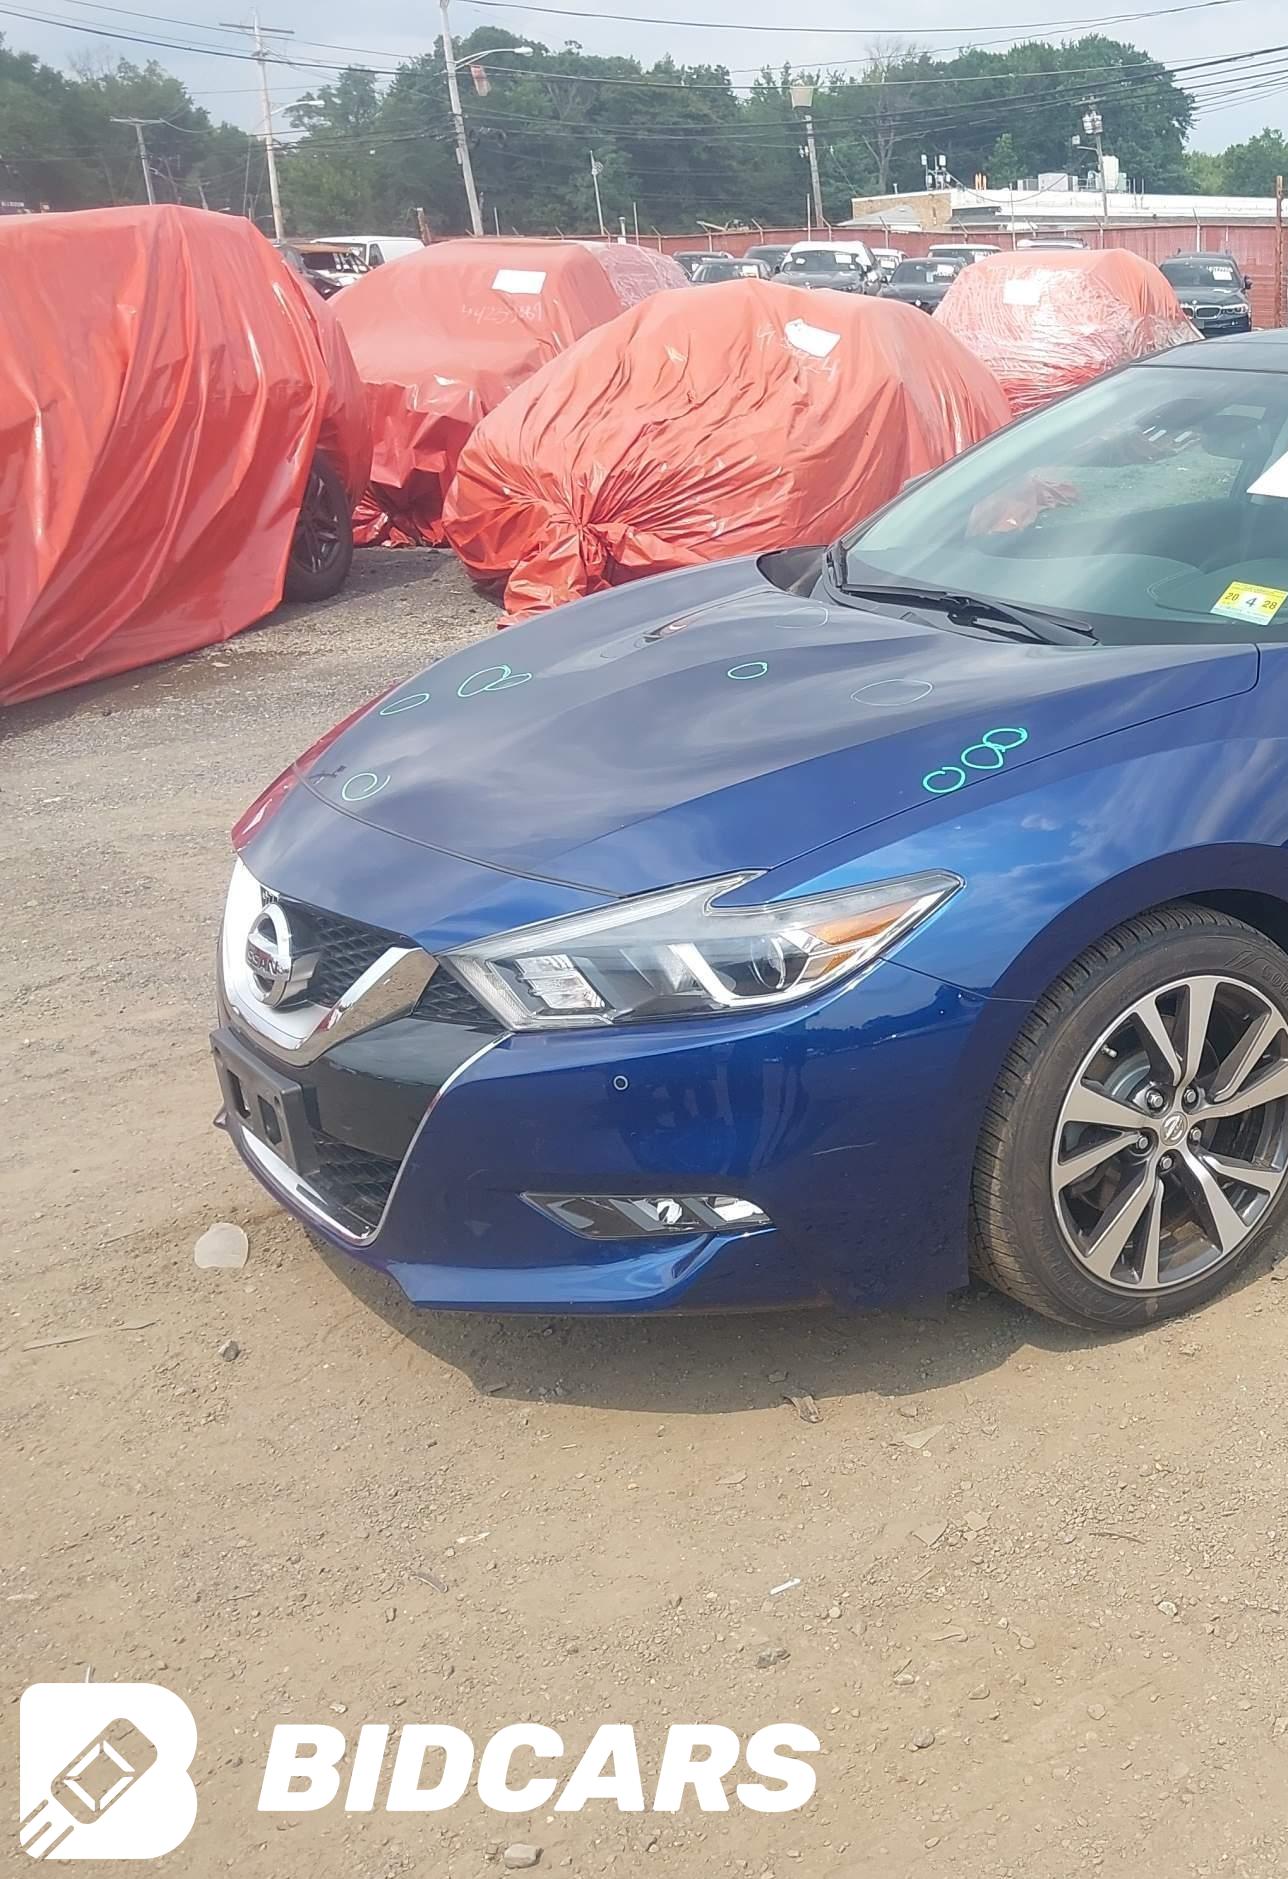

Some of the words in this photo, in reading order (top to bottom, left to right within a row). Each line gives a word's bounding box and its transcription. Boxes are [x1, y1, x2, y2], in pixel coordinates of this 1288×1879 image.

[1225, 592, 1240, 601] 20
[1245, 597, 1258, 607] 4
[1262, 600, 1278, 610] 28
